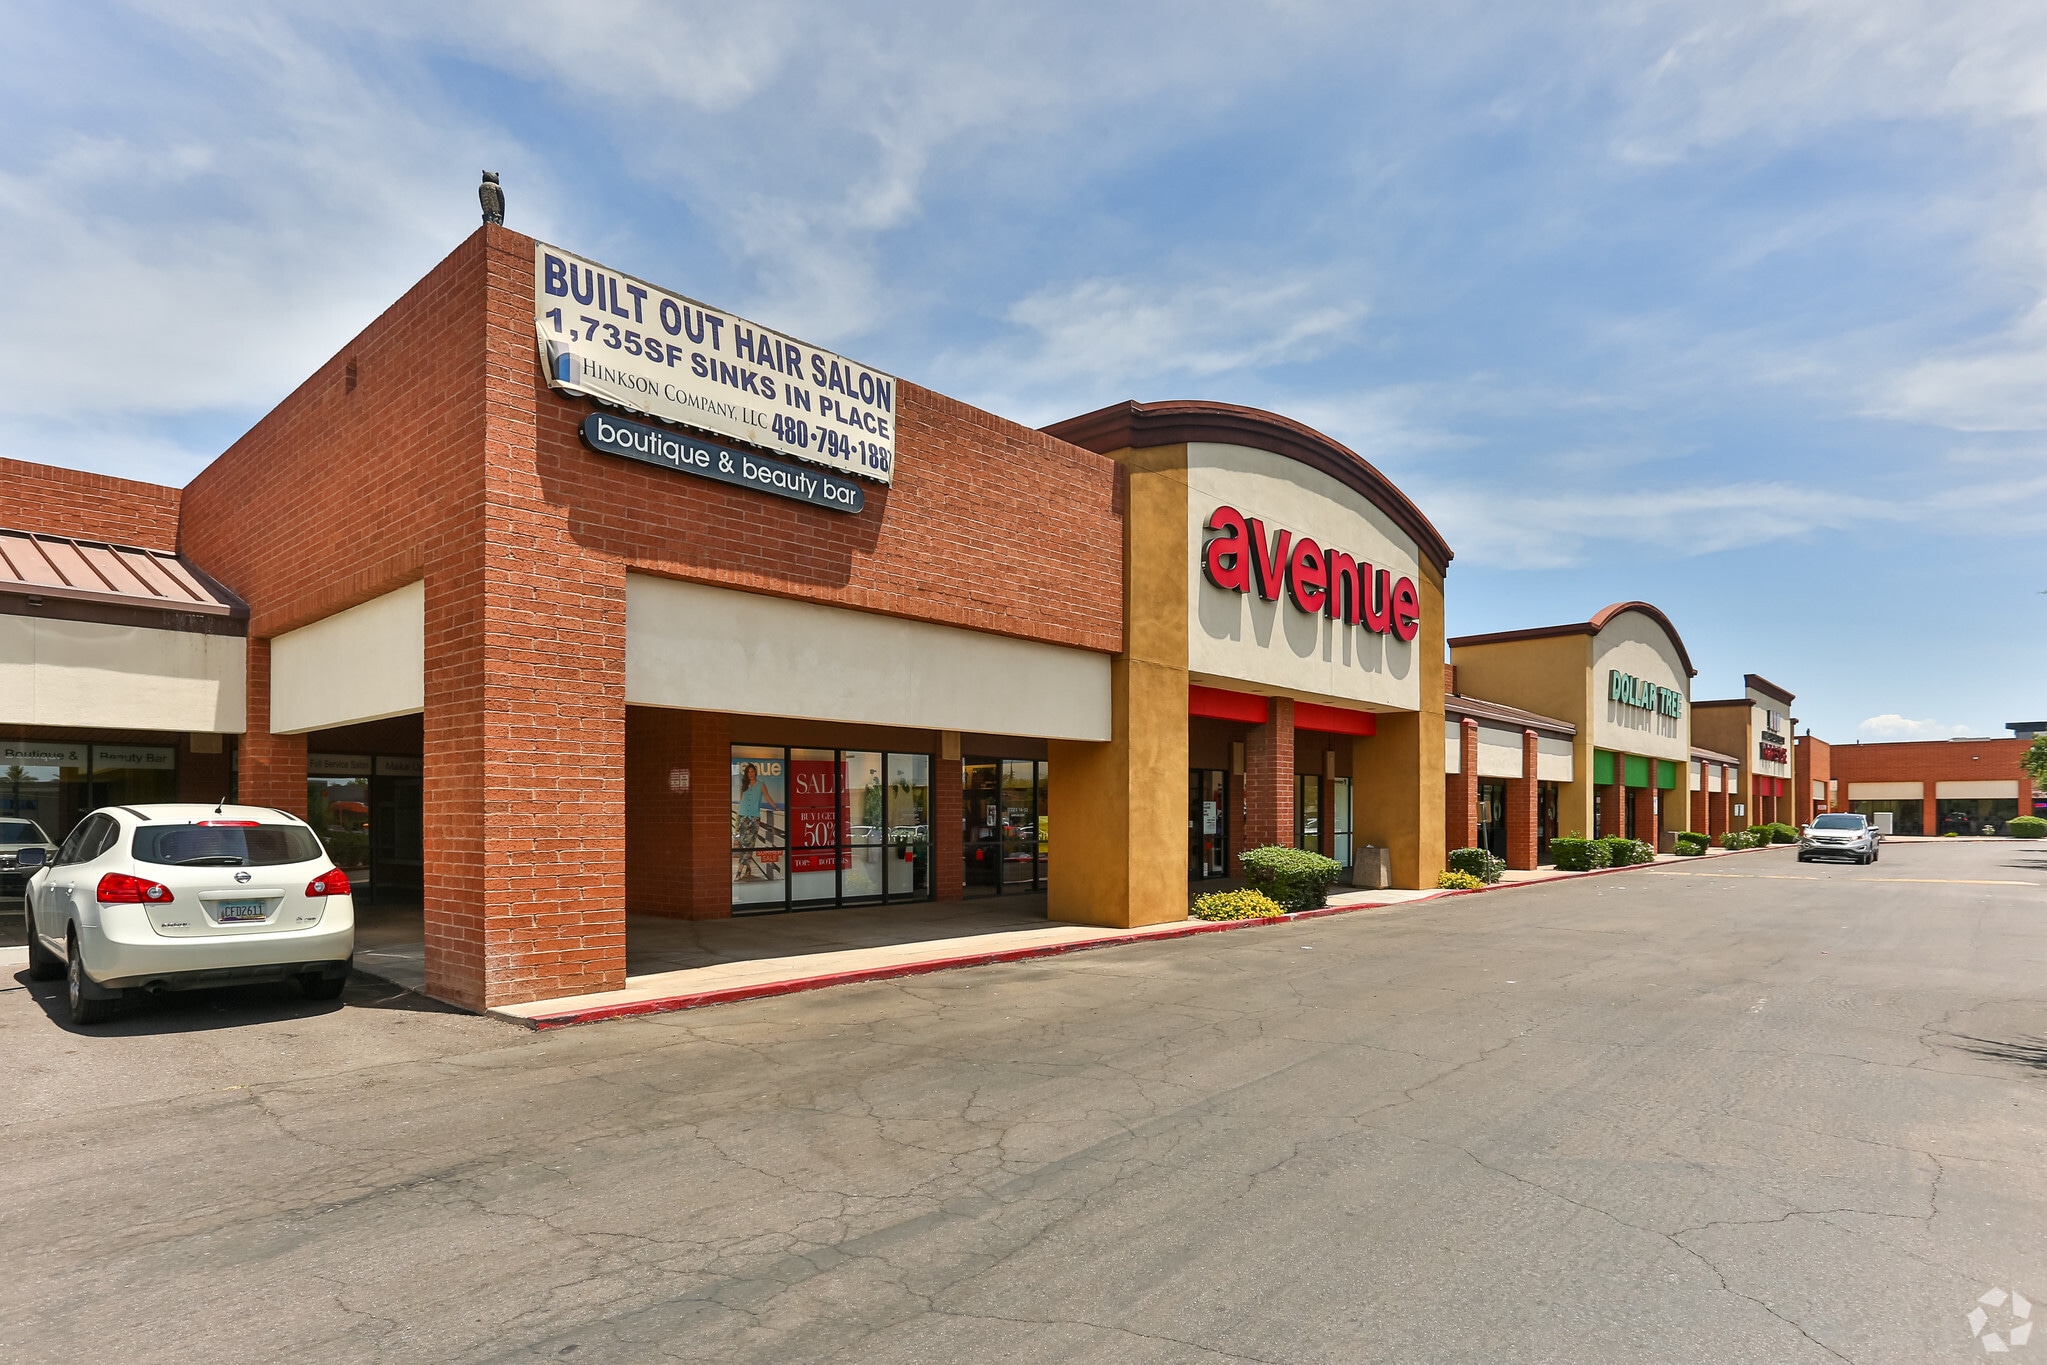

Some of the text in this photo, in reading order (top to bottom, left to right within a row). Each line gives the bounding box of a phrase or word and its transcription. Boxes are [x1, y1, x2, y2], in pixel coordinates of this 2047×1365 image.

[544, 253, 891, 413] BUILT OUT HAIR SALON
[545, 307, 890, 440] 1,735SF SINKS IN PLACE
[583, 357, 659, 396] HINKSON
[742, 409, 768, 430] LLC
[597, 418, 856, 505] boutique & beauty bar
[1202, 505, 1420, 642] avenue
[1608, 670, 1682, 719] DOLLAR TREE
[5, 749, 78, 762] Boutique &
[100, 752, 168, 765] Beauty Bar
[324, 760, 348, 769] Service
[351, 760, 369, 769] Salon
[801, 812, 815, 821] BUY
[225, 905, 263, 916] CFD2611
